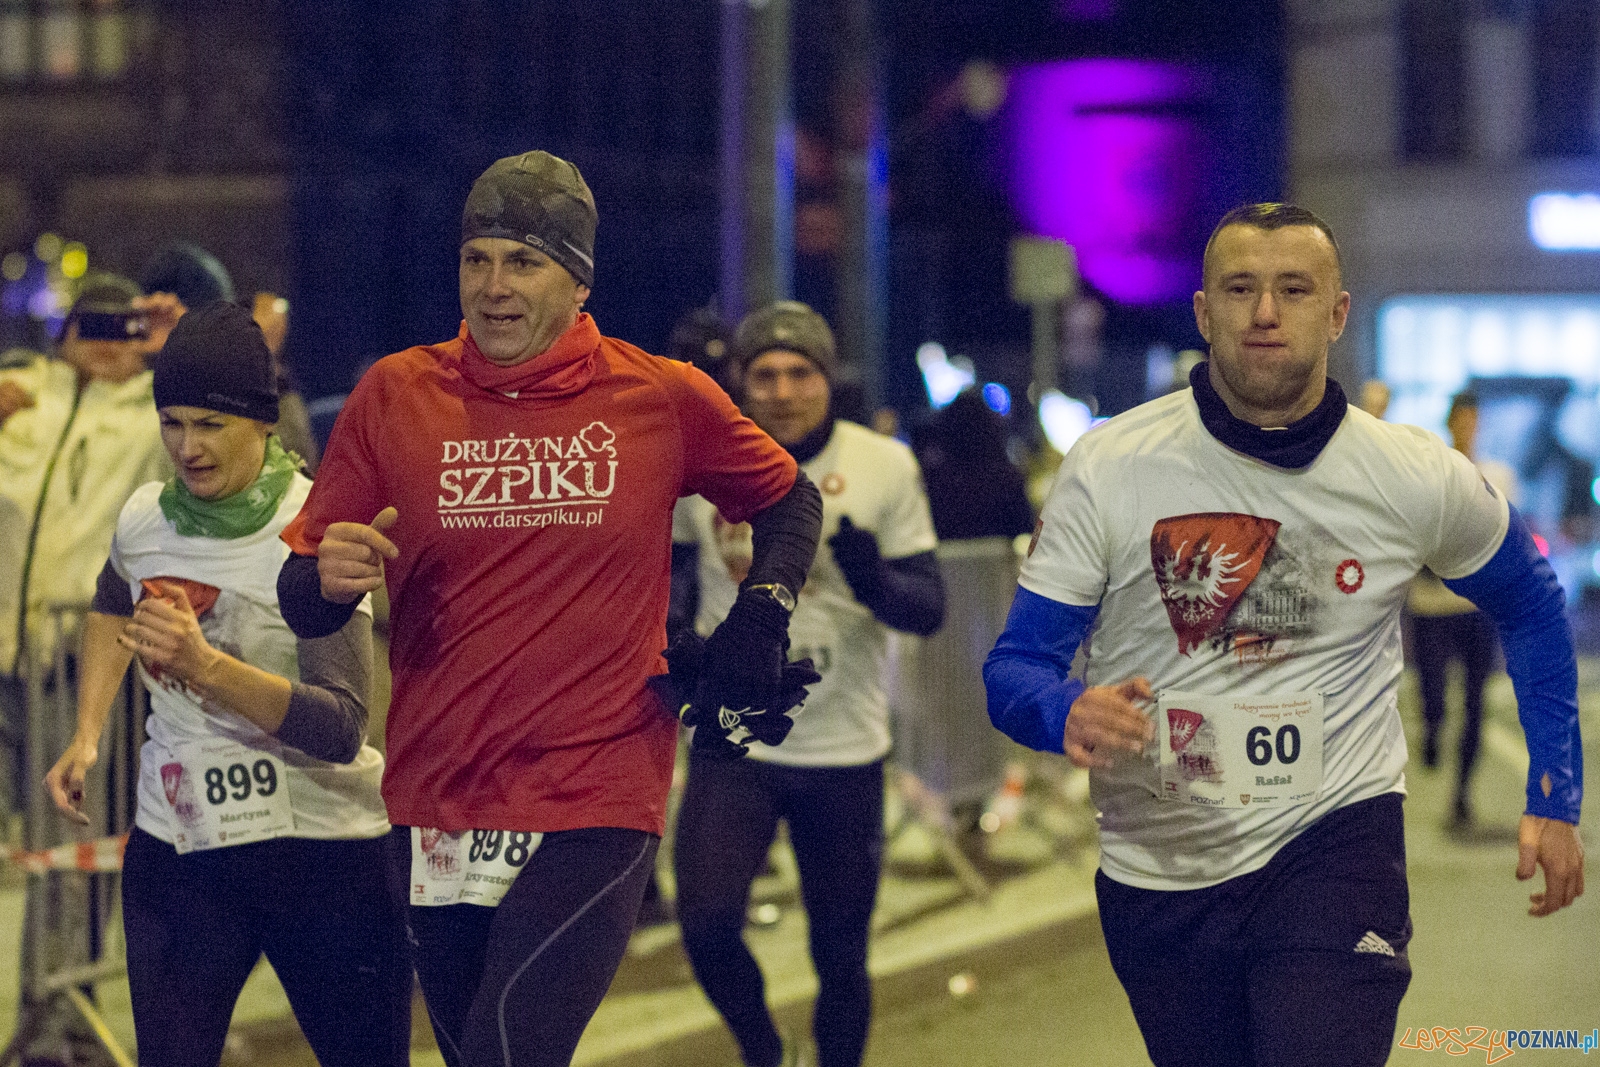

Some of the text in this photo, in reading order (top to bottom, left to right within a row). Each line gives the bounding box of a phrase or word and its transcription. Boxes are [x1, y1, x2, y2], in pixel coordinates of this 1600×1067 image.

[441, 432, 588, 463] DRUŻYNA
[438, 461, 619, 507] SZPIKU
[440, 508, 603, 528] www.darszpiku.pl
[1246, 724, 1300, 766] 60
[205, 759, 277, 805] 899
[468, 829, 532, 867] 898
